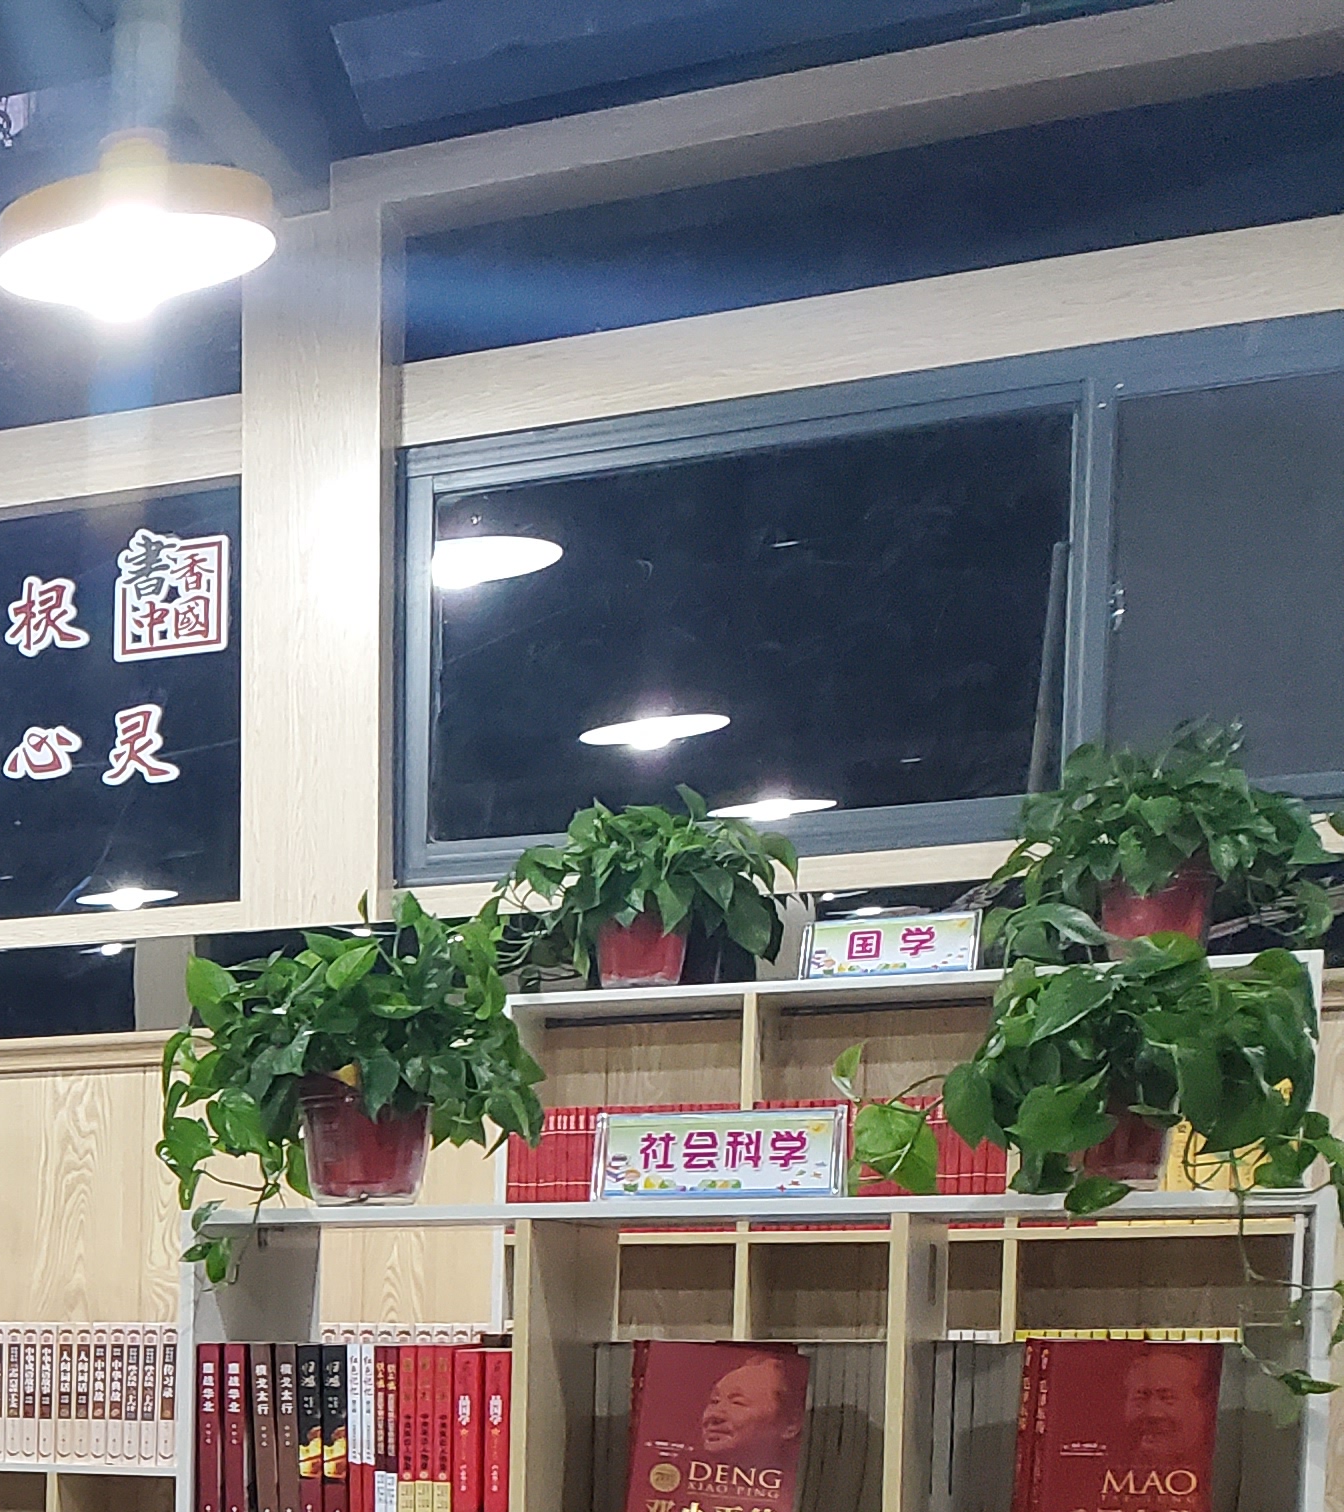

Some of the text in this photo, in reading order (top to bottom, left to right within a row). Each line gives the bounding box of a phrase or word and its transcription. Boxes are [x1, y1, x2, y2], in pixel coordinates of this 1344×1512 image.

[847, 925, 936, 961] 国学
[639, 1129, 808, 1171] 社会科学
[687, 1460, 784, 1490] DENG
[1100, 1468, 1198, 1496] MAO
[687, 1481, 781, 1500] XIAO PING
